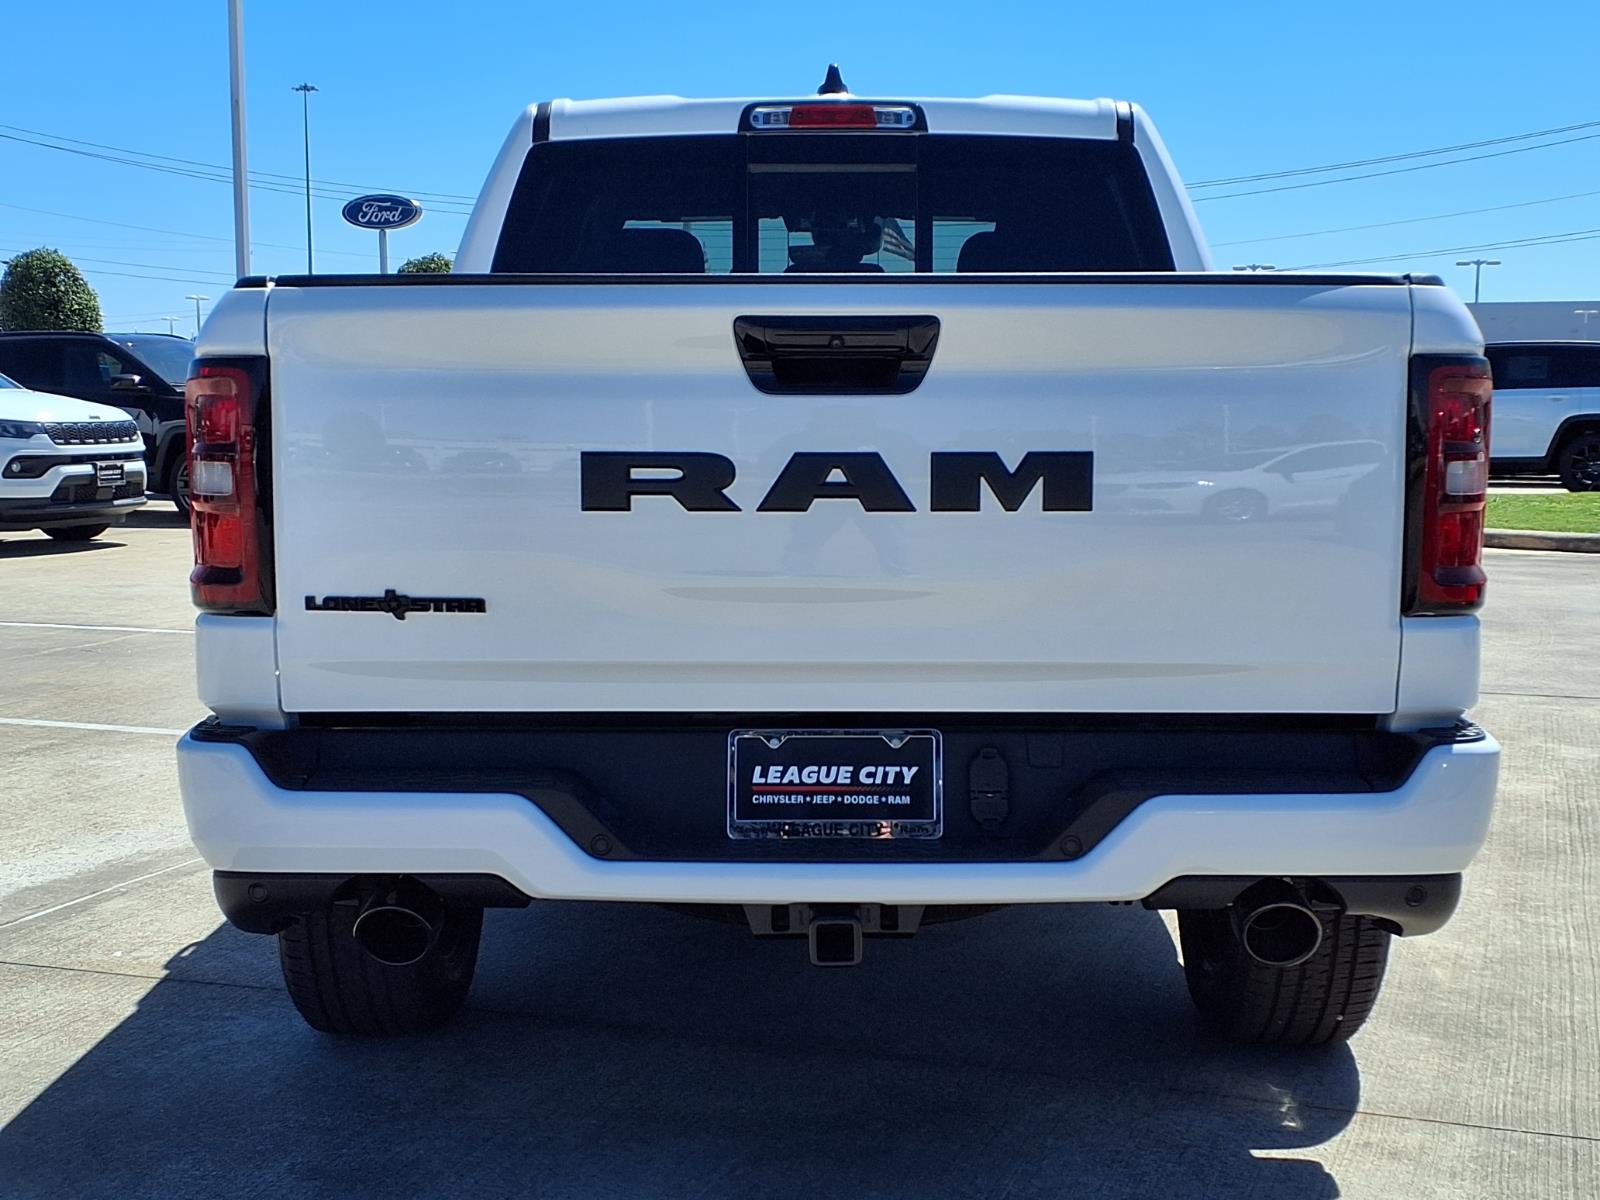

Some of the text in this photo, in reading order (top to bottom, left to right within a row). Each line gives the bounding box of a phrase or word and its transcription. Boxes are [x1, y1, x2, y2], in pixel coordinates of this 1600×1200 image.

[358, 201, 402, 223] Ford
[581, 450, 1094, 512] RAM
[752, 765, 919, 784] LEAGUE CITY
[752, 794, 911, 804] CHRYSLER JEEP DODGE RAM
